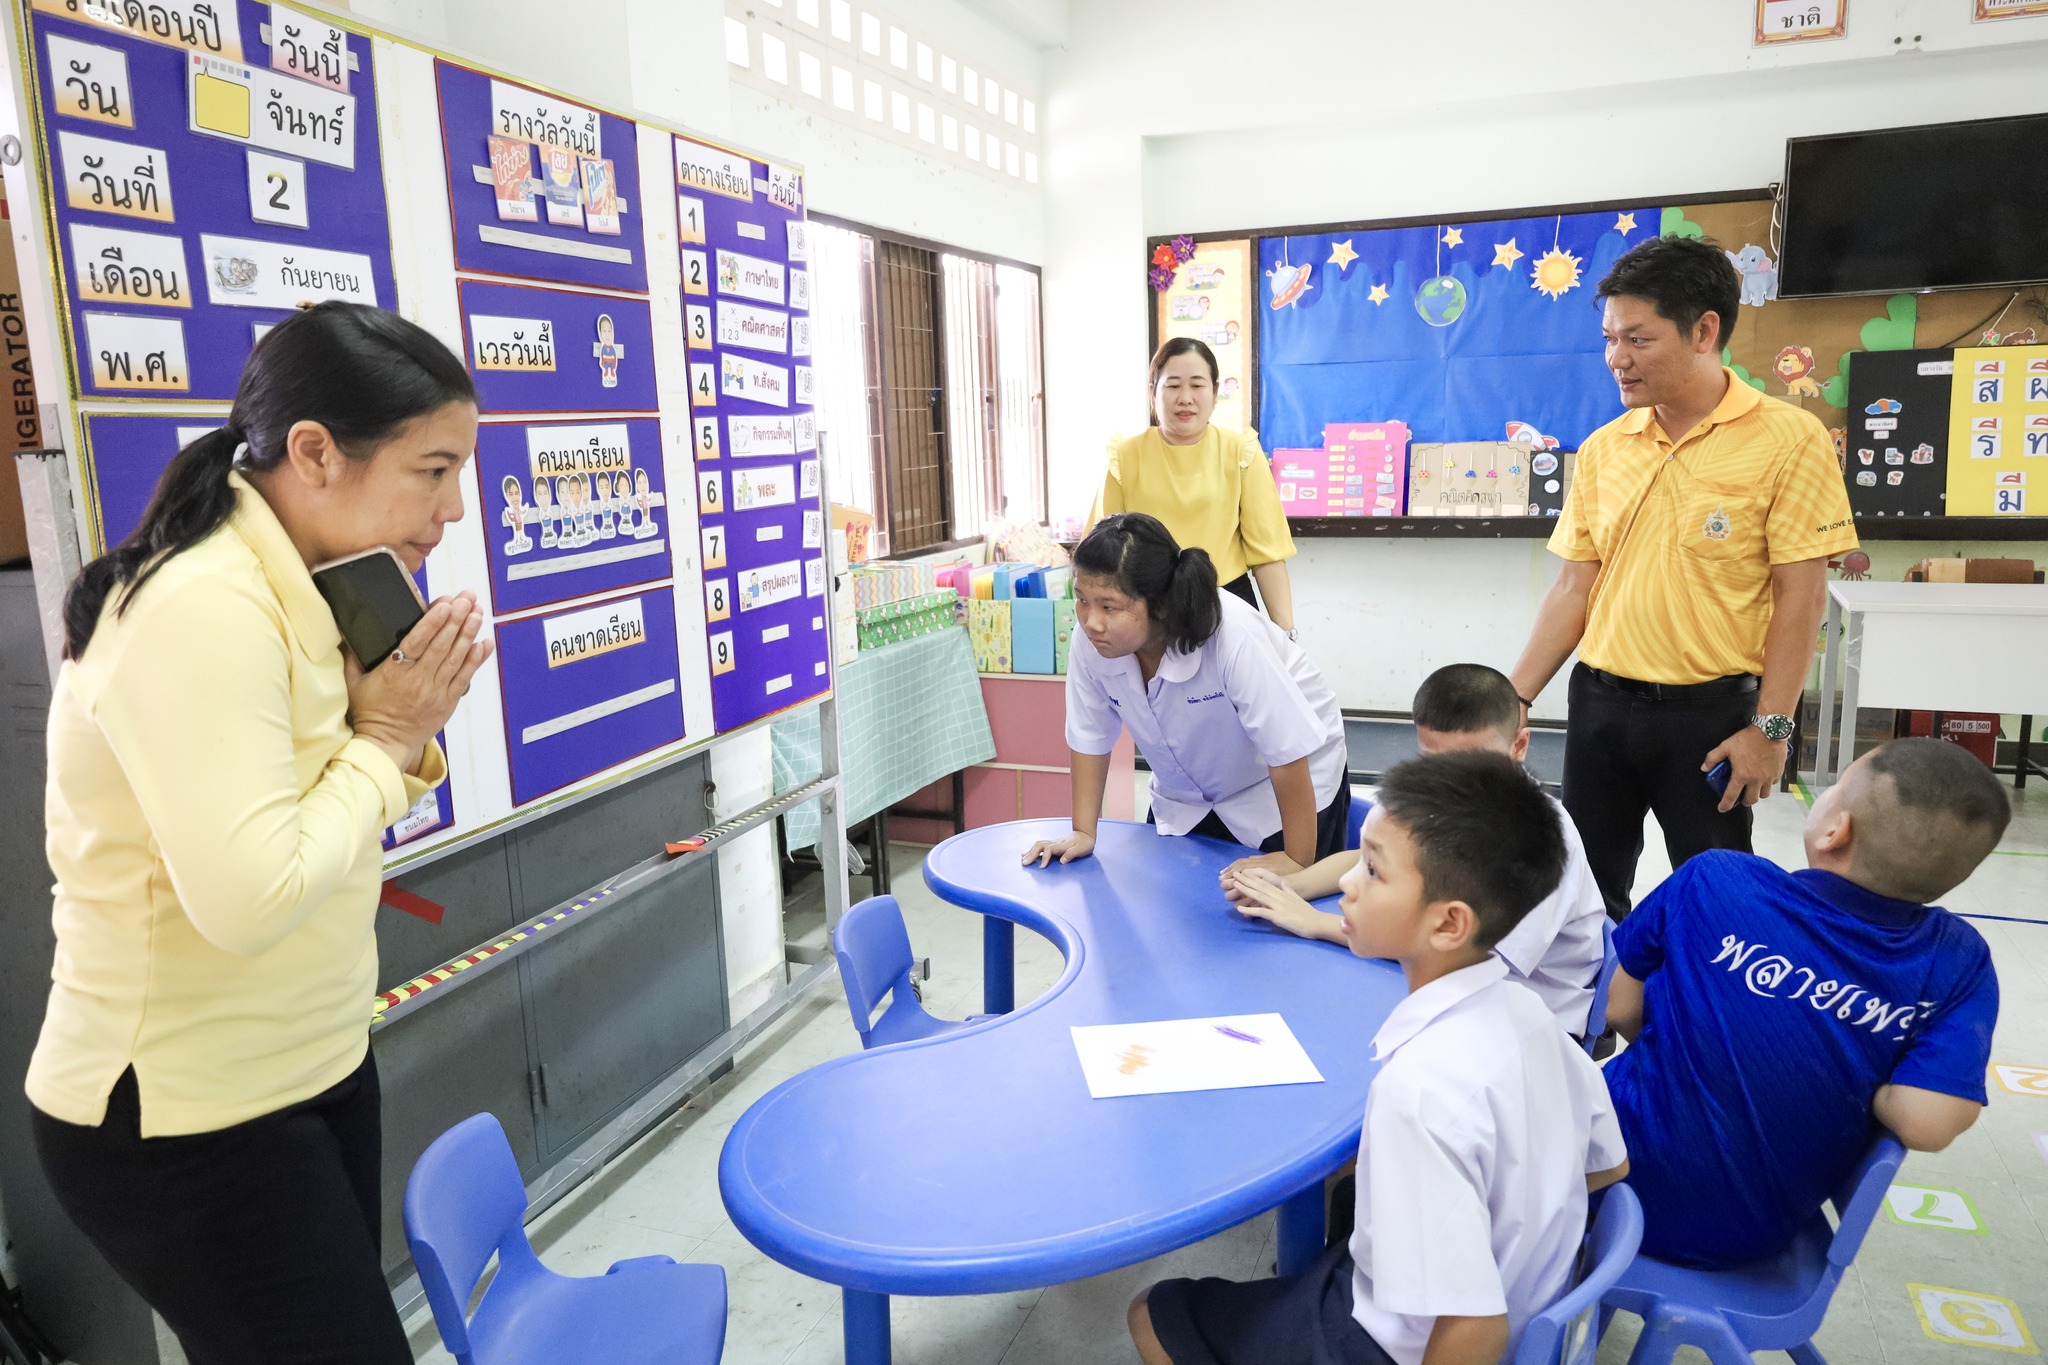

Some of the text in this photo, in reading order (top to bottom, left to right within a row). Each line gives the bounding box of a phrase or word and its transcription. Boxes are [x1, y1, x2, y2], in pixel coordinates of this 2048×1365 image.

[1781, 6, 1820, 29] ชาติ
[280, 24, 342, 84] วันนี้
[65, 60, 119, 117] วัน
[266, 88, 345, 146] จันทร์
[499, 107, 596, 156] รางวัลวันนี้
[80, 154, 160, 214] วันที่
[267, 171, 291, 211] 2
[681, 164, 750, 197] ตารางเรียน
[771, 173, 797, 208] วันนี้
[688, 207, 696, 233] 1
[88, 246, 180, 300] เดือน
[280, 257, 361, 293] กันยายน
[690, 260, 701, 285] 2
[744, 268, 779, 290] ภาษาไทย
[695, 315, 705, 340] 3
[741, 315, 786, 339] คณิตศาสตร์
[478, 322, 552, 367] เวรวันนี้
[100, 349, 179, 384] พ.ศ.
[699, 372, 709, 397] 4
[703, 425, 713, 450] 5
[538, 437, 624, 472] คนมาเรียน
[707, 480, 717, 503] 6
[757, 481, 776, 498] พละ
[1816, 525, 1828, 533] WE
[1829, 519, 1846, 530] LOVE
[709, 535, 719, 560] 7
[762, 571, 798, 596] สรุปผลงาน
[713, 587, 724, 612] 8
[550, 613, 642, 661] คนขาดเรียน
[717, 641, 728, 665] 9
